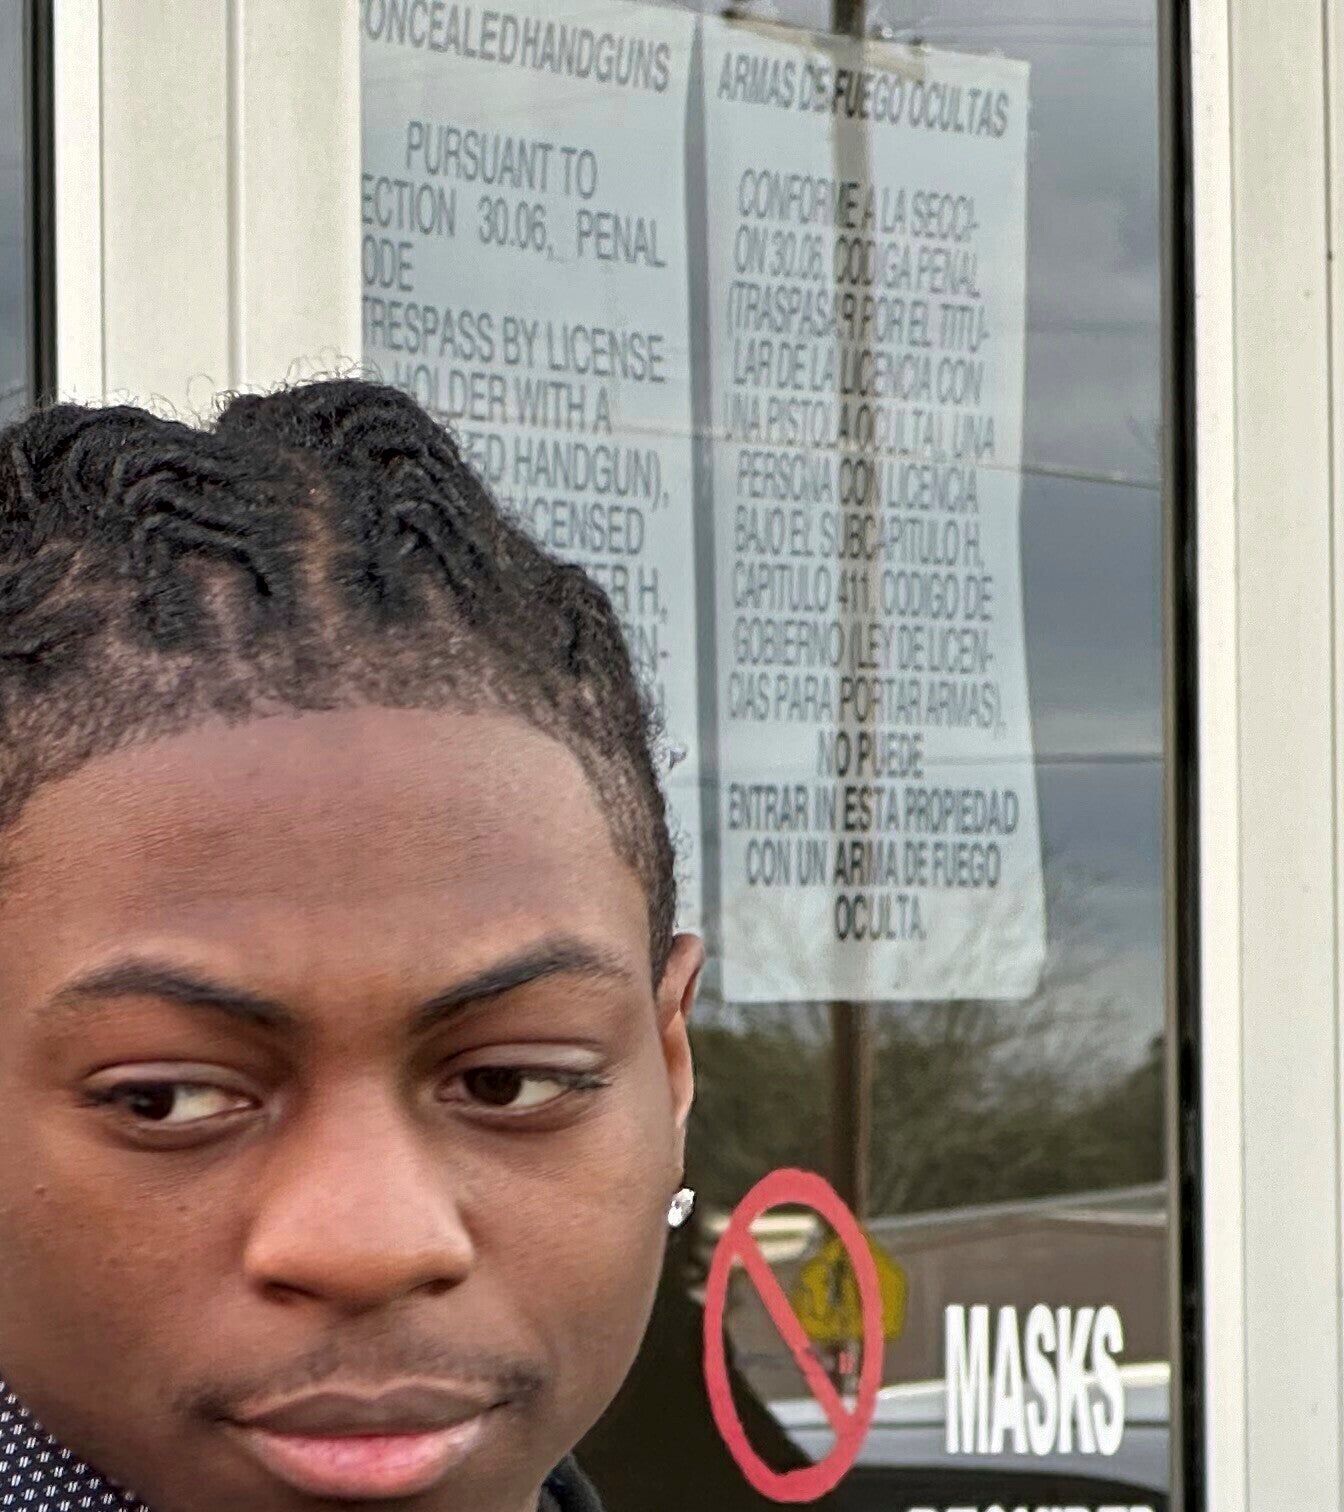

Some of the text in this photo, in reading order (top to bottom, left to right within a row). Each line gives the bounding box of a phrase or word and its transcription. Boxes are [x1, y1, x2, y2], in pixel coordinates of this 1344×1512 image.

[364, 0, 670, 92] ONCEALED HANDGUNS
[407, 121, 598, 199] PURSUANT TO
[362, 172, 456, 237] ECTION
[576, 208, 667, 268] PENAL
[362, 234, 414, 292] ODE
[504, 316, 539, 369] BY
[547, 320, 665, 383] LICENSE
[515, 377, 585, 431] WITH
[593, 386, 612, 434] A
[513, 436, 669, 514] HANDGUN),
[945, 1304, 1124, 1455] MASKS
